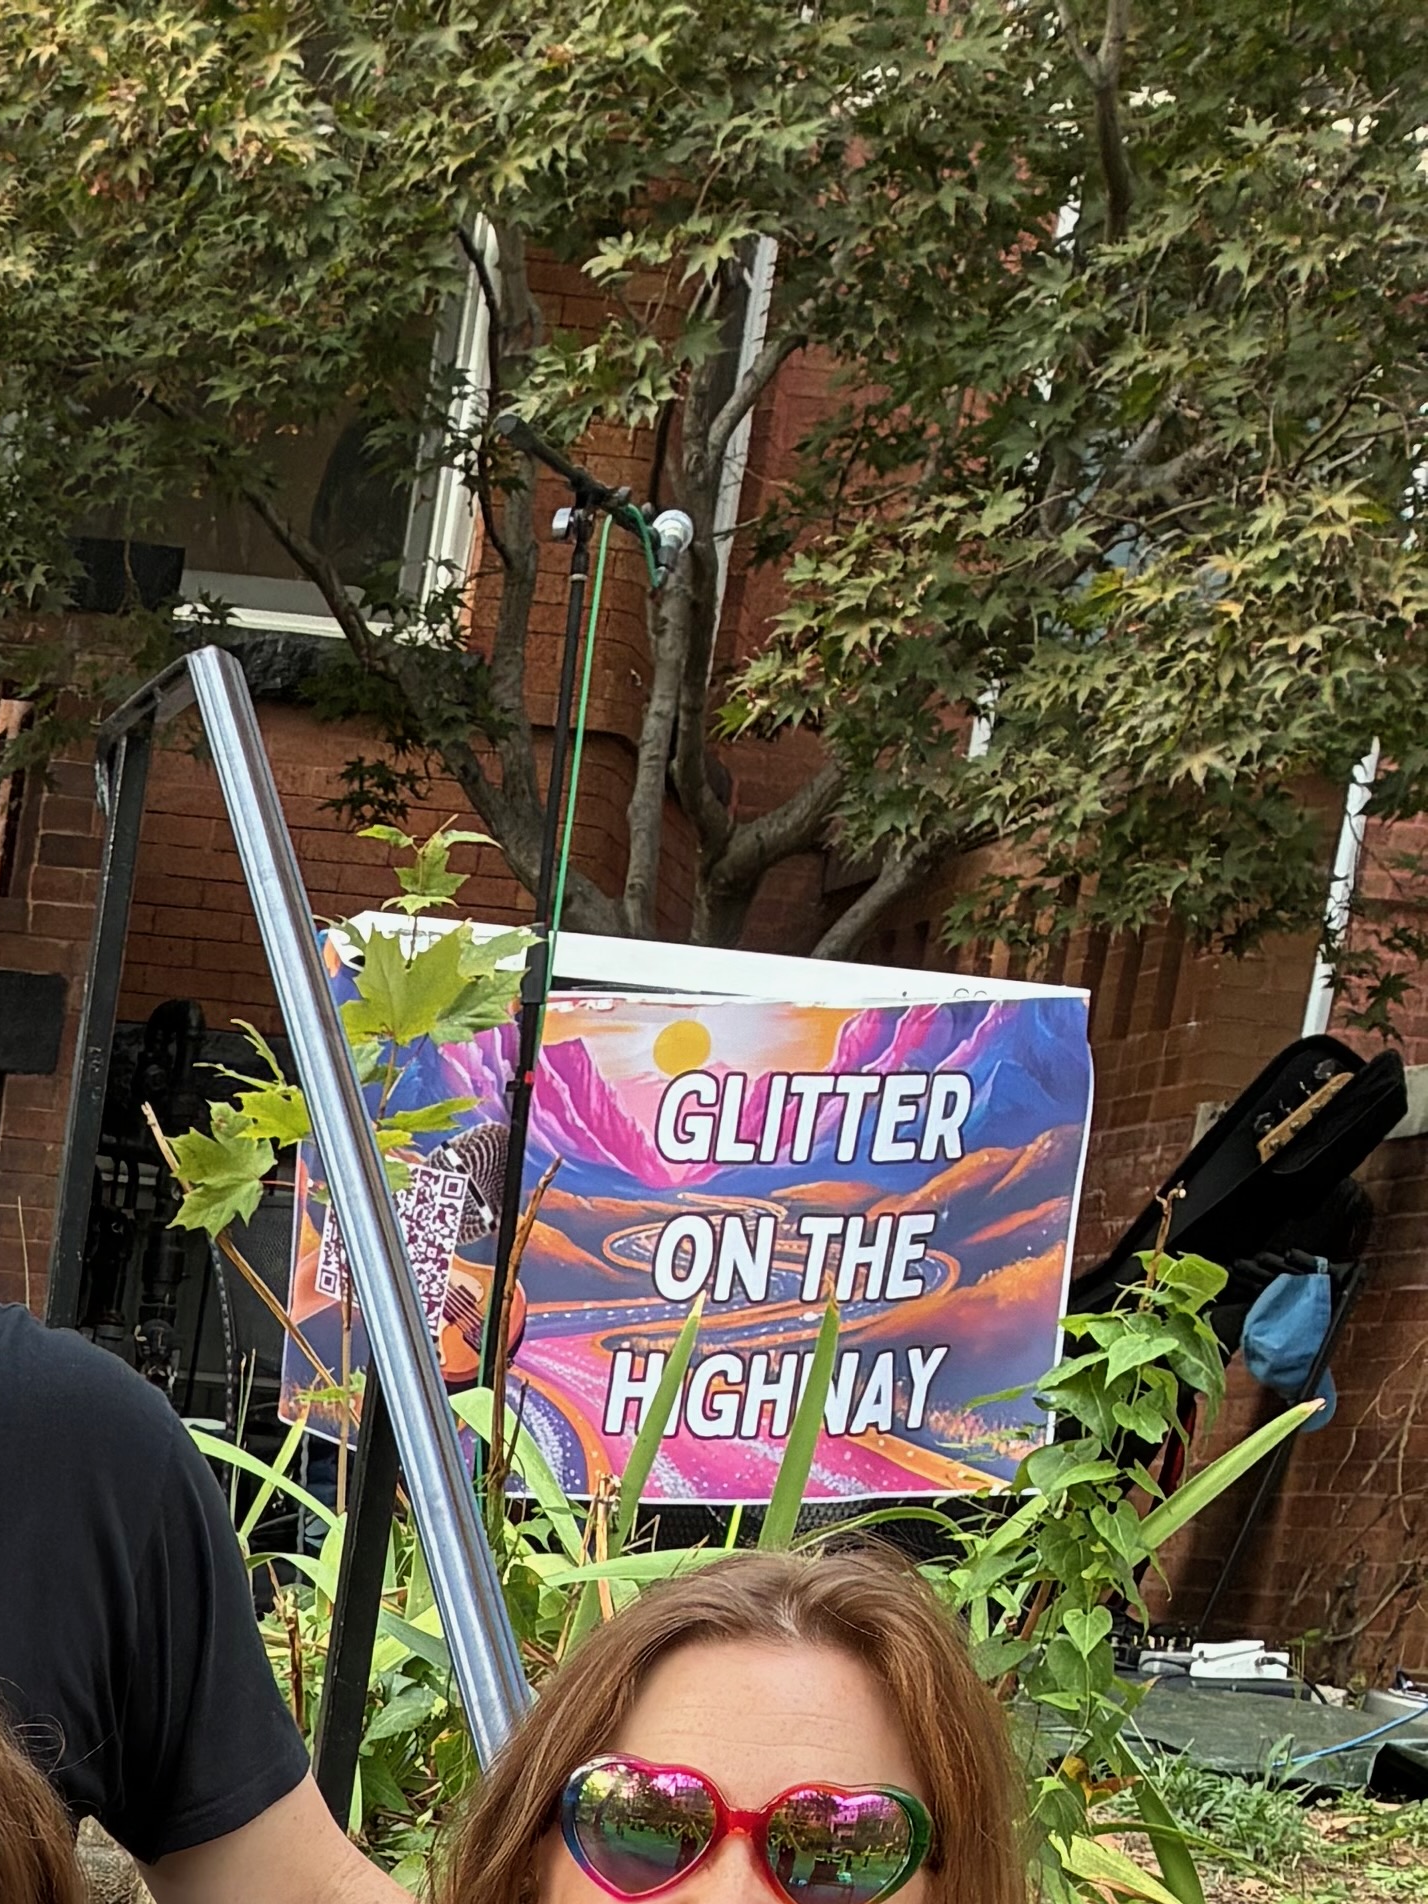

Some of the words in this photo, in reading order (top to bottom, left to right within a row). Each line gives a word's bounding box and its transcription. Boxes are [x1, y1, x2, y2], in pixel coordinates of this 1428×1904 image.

[654, 1070, 974, 1165] GLITTER
[652, 1211, 779, 1302] ON
[797, 1209, 937, 1302] THE
